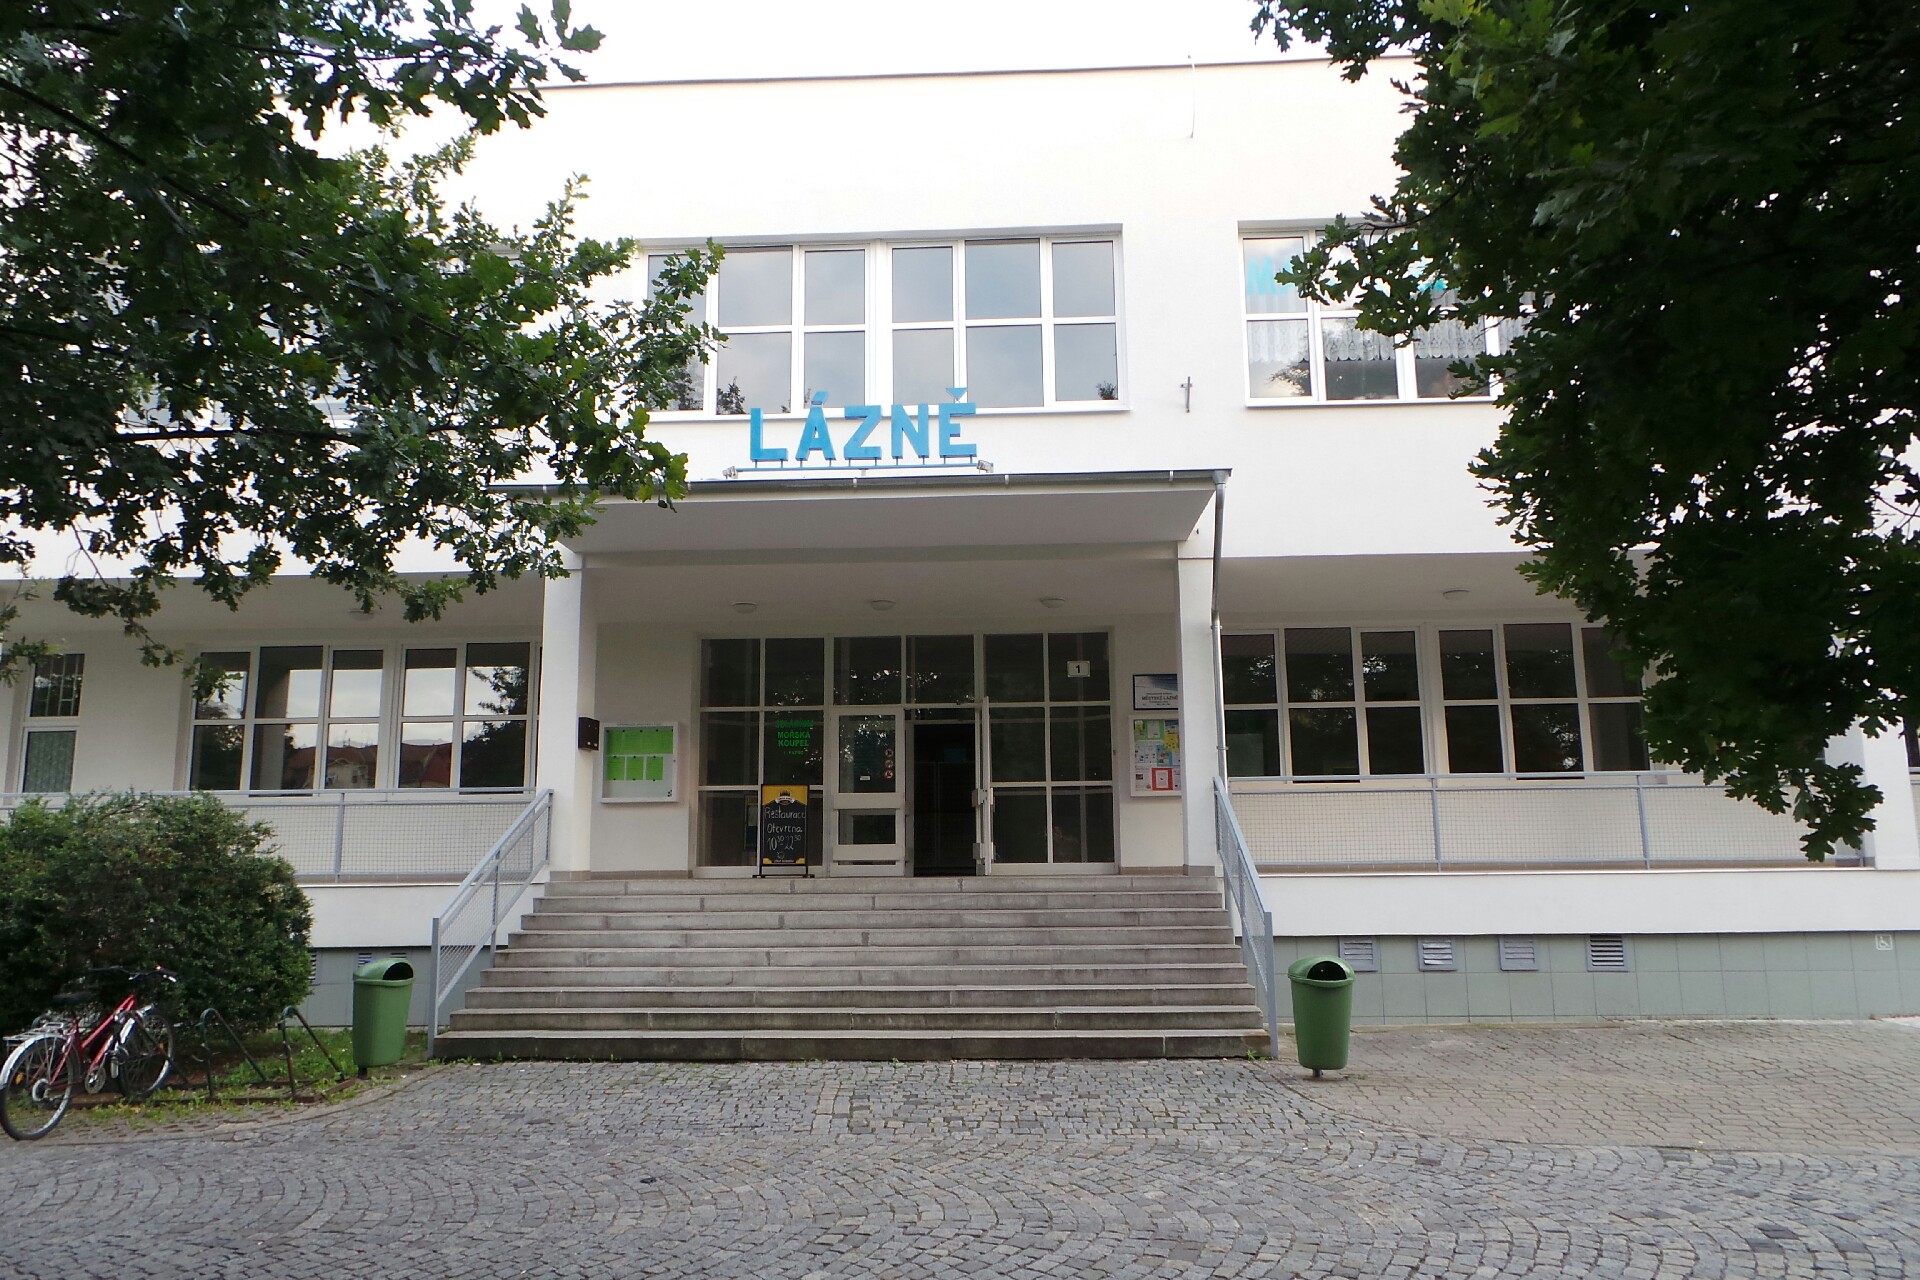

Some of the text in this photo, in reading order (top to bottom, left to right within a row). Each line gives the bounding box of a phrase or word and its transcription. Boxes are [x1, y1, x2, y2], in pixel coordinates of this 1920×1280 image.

[750, 387, 977, 462] LÁZNĚ
[1075, 664, 1080, 674] 1
[777, 739, 810, 747] KOUPEL
